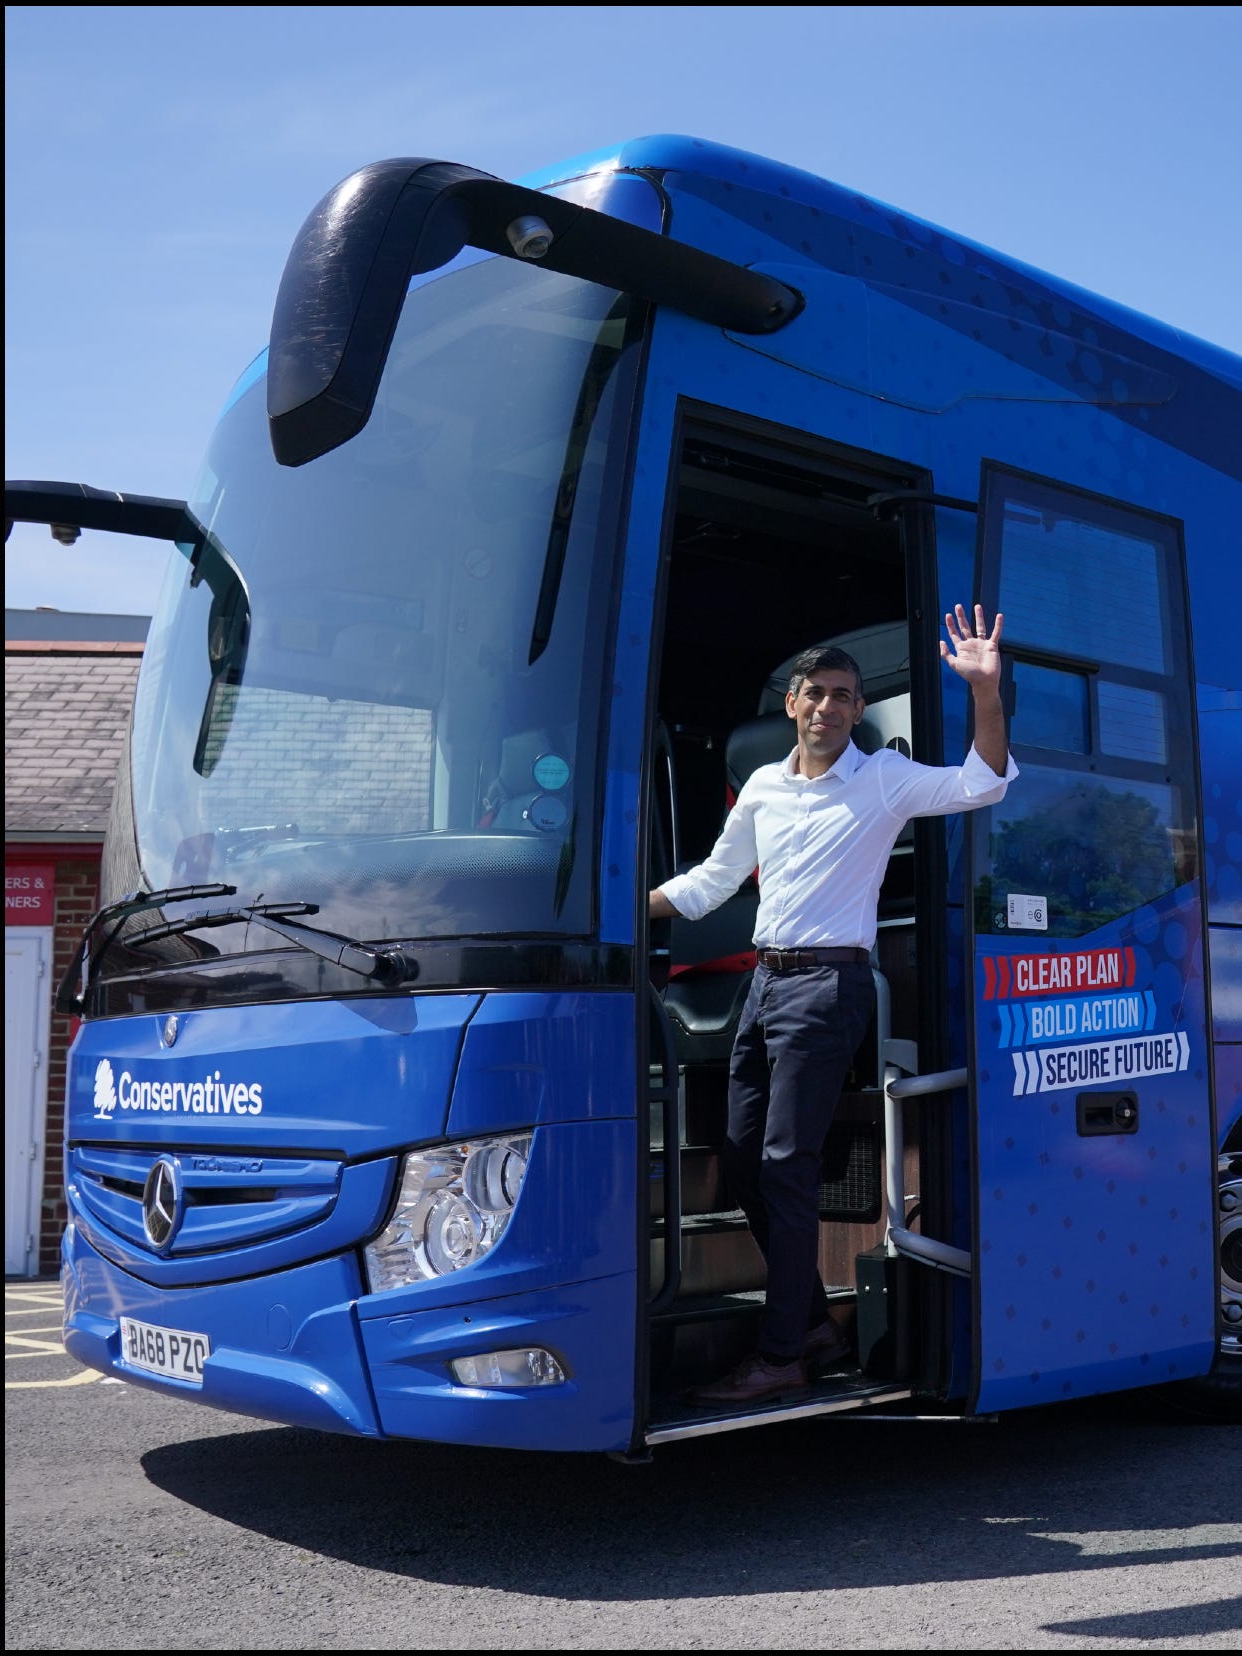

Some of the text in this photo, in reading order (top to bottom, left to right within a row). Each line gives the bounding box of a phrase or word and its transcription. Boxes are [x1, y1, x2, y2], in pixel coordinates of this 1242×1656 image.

[34, 877, 45, 889] &
[1017, 953, 1119, 991] CLEAR PLAN
[1031, 997, 1139, 1039] BOLD ACTION
[1045, 1038, 1174, 1086] SECURE FUTURE
[118, 1070, 263, 1115] Conservatives
[129, 1324, 166, 1367] BA68
